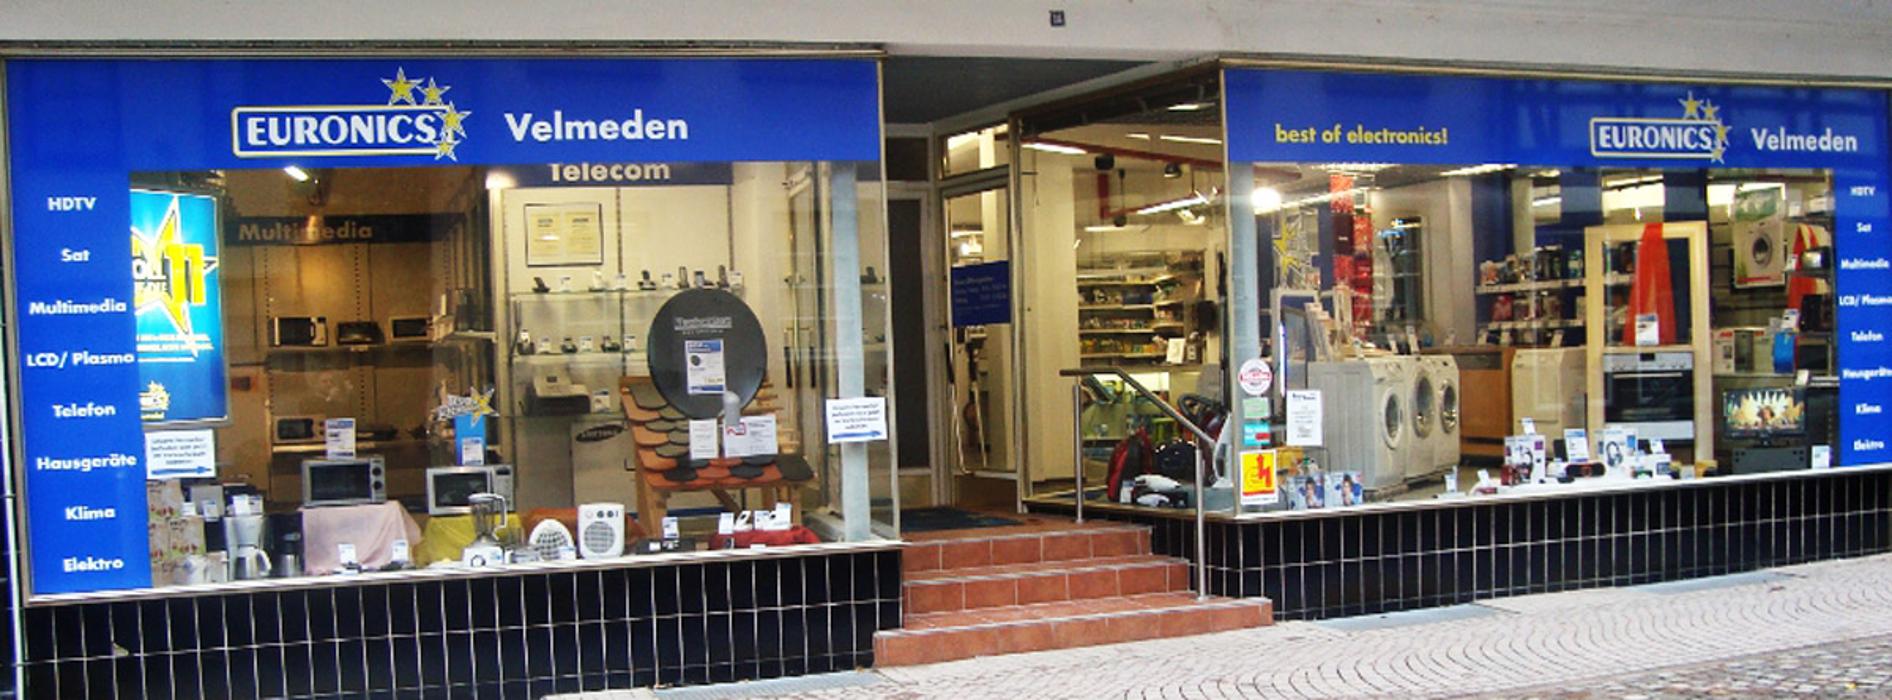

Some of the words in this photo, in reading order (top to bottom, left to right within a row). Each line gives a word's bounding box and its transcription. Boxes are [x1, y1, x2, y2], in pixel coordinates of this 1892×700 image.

[246, 114, 437, 146] EURONICS
[504, 108, 689, 142] Velmeden
[1275, 124, 1317, 143] best
[1321, 123, 1342, 144] of
[1346, 124, 1449, 145] electronics!
[1598, 125, 1713, 150] EURONICS
[1750, 126, 1858, 152] Velmeden
[548, 163, 671, 183] Telecom
[1850, 186, 1876, 196] HDTV
[47, 197, 97, 211] HDTV
[1856, 222, 1872, 232] Sat
[60, 248, 90, 262] Sat
[1840, 257, 1890, 270] Multimedia
[29, 298, 127, 315] Multimedia
[1851, 330, 1884, 342] Telefon
[27, 351, 68, 368] LCD/
[72, 350, 135, 366] Plasma
[52, 402, 116, 417] Telefon
[1855, 403, 1882, 414] Klima
[1853, 439, 1885, 451] Elektro
[36, 453, 137, 472] Hausgeräte
[64, 505, 116, 520] Klima
[63, 556, 124, 573] Elektro
